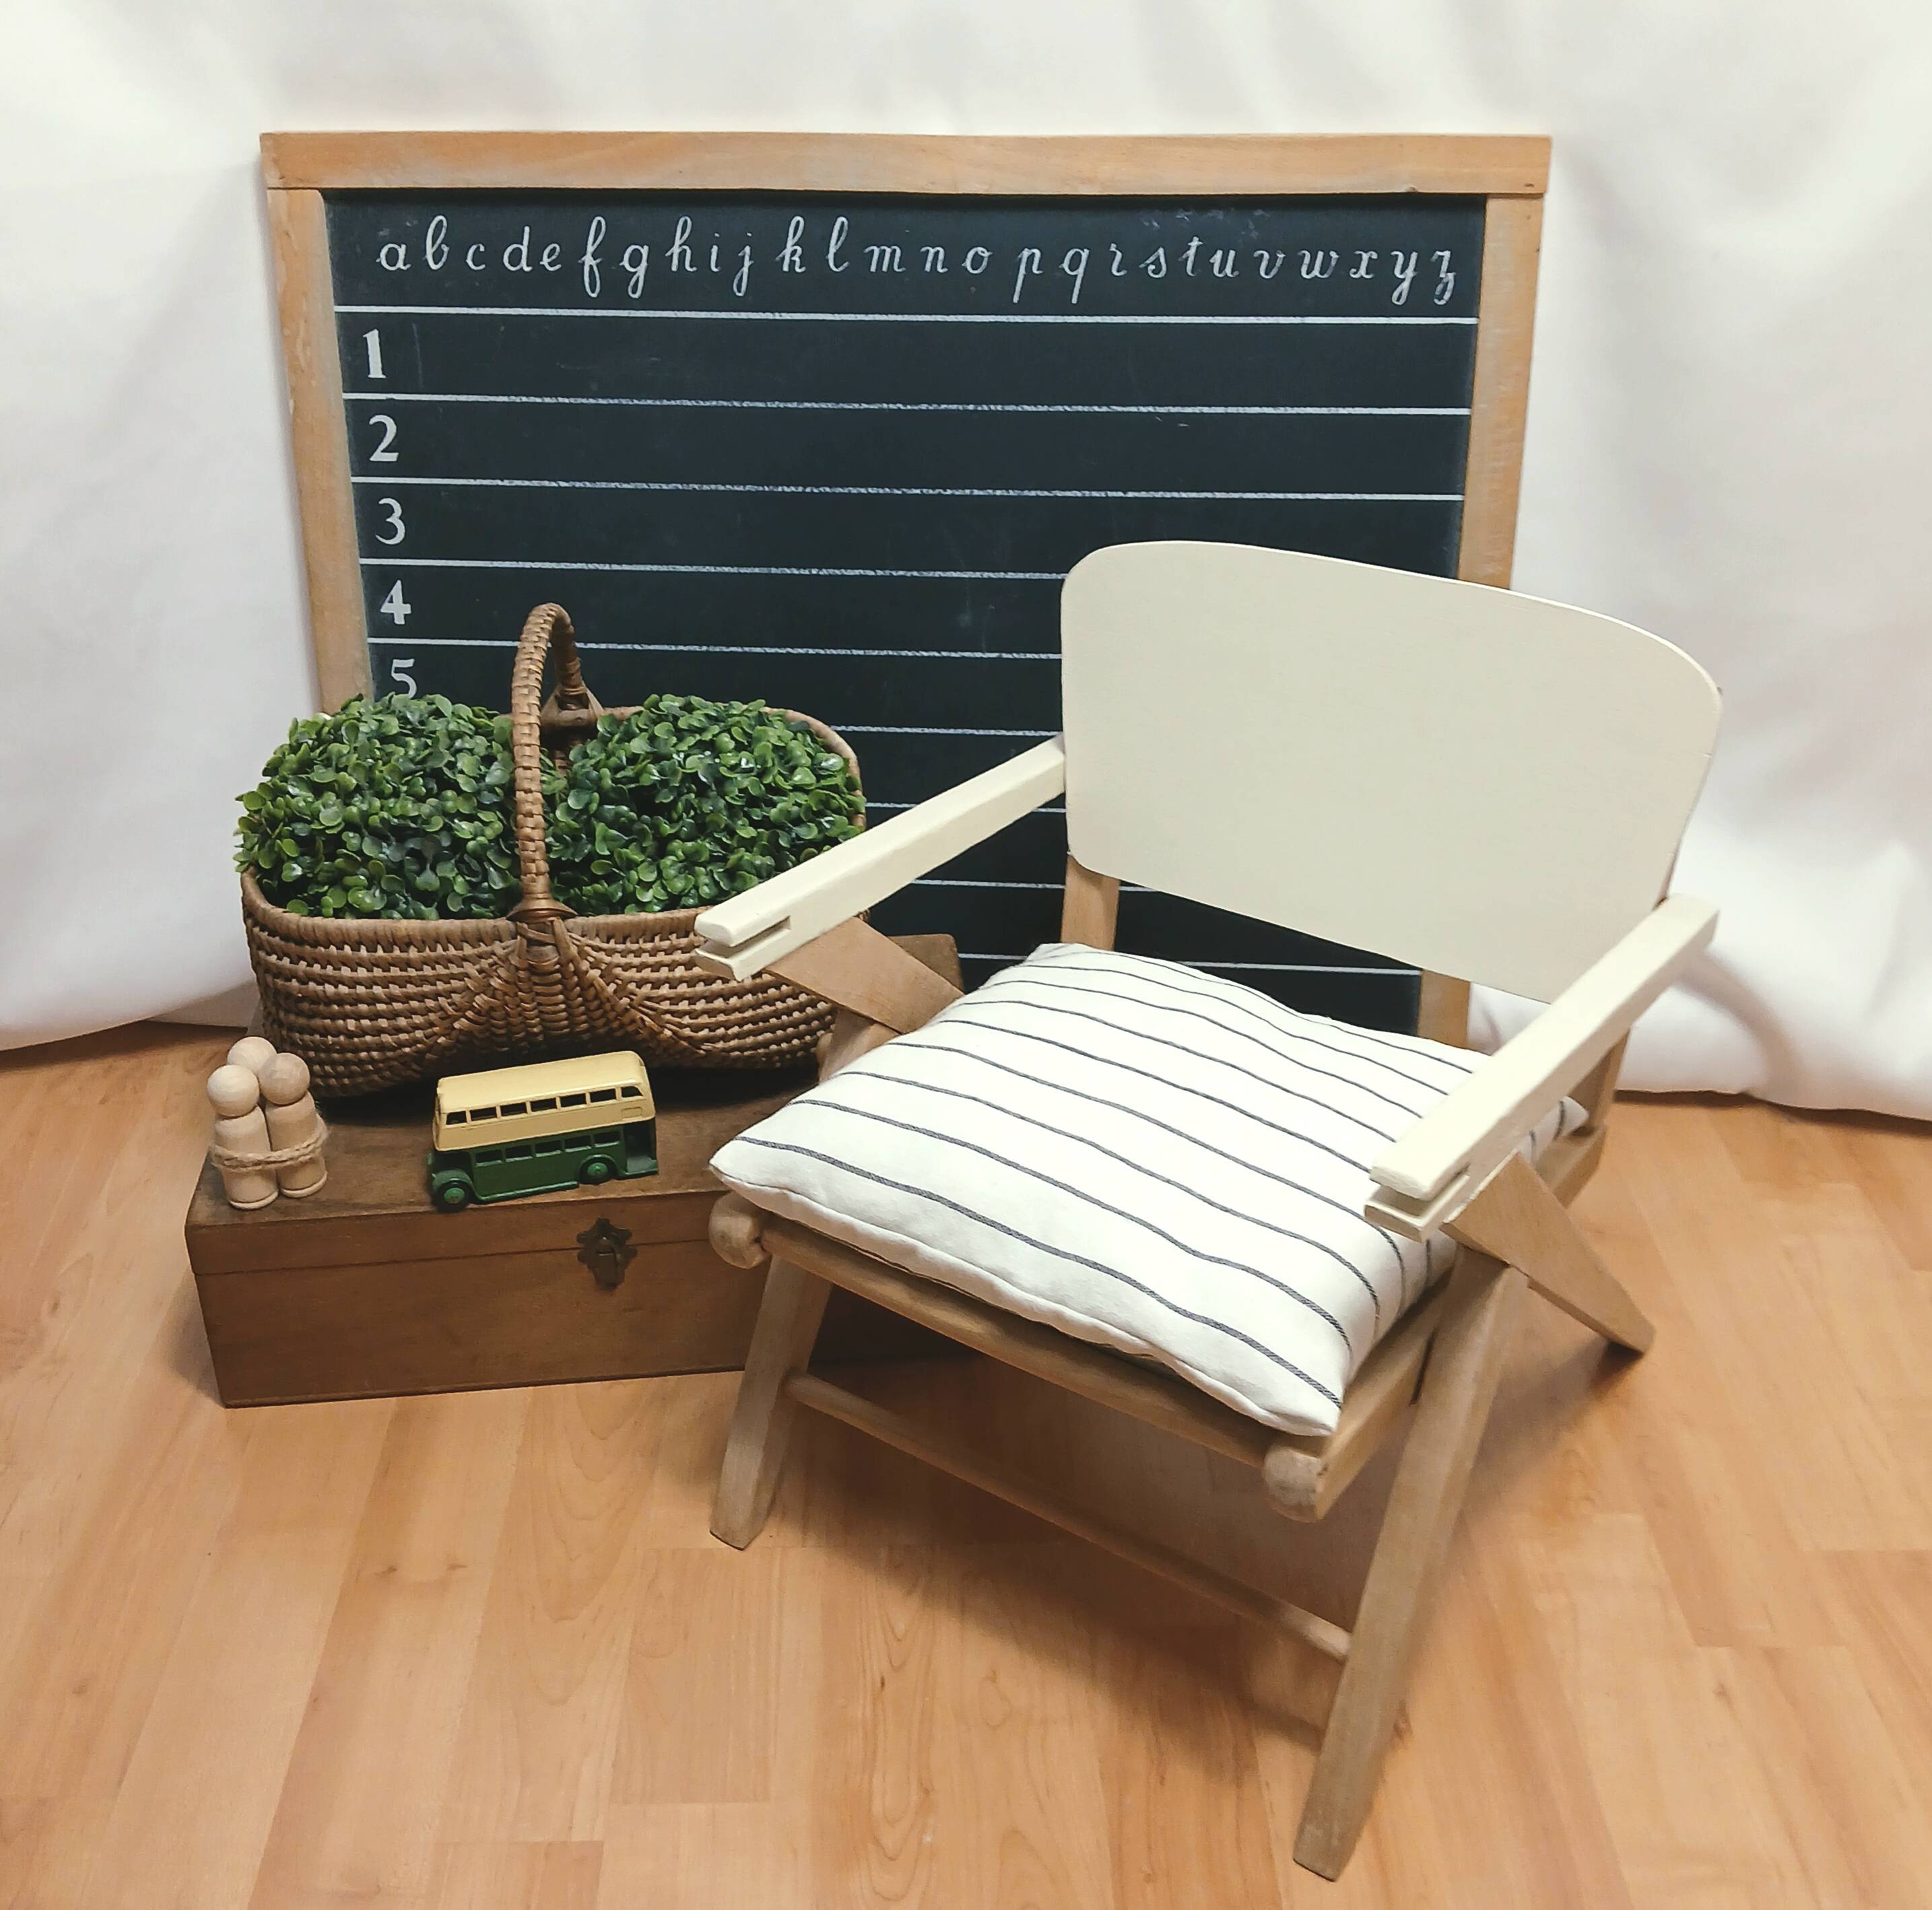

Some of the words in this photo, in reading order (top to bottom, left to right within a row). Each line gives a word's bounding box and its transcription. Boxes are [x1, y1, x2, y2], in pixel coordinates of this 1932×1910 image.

[375, 242, 411, 271] a
[425, 214, 450, 271] b
[465, 243, 486, 271] c
[502, 226, 533, 272] d
[539, 243, 562, 271] e
[578, 215, 607, 298] f
[619, 244, 650, 299] g
[665, 215, 698, 273] h
[708, 232, 721, 272] i
[733, 233, 754, 297] j
[774, 215, 806, 273] k
[826, 216, 850, 272] l
[864, 245, 906, 273] m
[920, 245, 949, 273] n
[961, 246, 993, 275] o
[1012, 247, 1043, 304] p
[1059, 248, 1090, 304] q
[1139, 246, 1168, 279] s
[1181, 236, 1204, 277] t
[1209, 249, 1240, 277] u
[1253, 250, 1286, 279] v
[1298, 250, 1340, 279] w
[1348, 250, 1378, 279] x
[1390, 250, 1419, 306] y
[362, 329, 387, 378] 1
[369, 414, 399, 462] 2
[375, 498, 405, 545] 3
[380, 580, 411, 625] 4
[391, 658, 418, 699] 5
